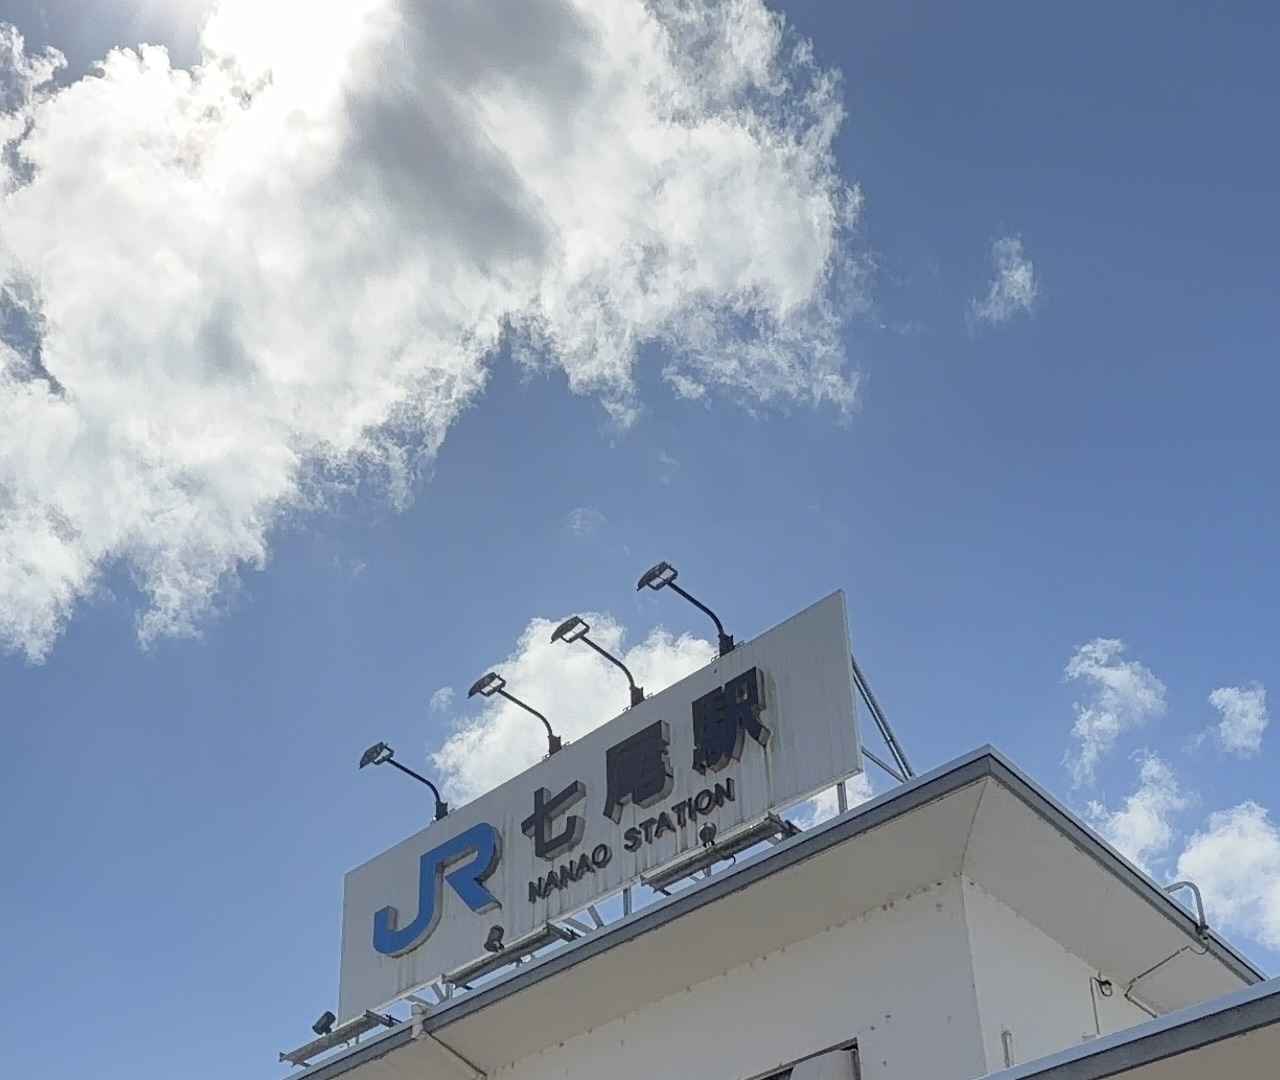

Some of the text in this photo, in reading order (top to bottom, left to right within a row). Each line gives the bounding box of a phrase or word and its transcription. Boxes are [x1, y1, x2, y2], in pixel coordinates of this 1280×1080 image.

[521, 667, 771, 859] 七尾駅
[373, 822, 503, 957] JR
[528, 778, 736, 904] NANAO STATION
